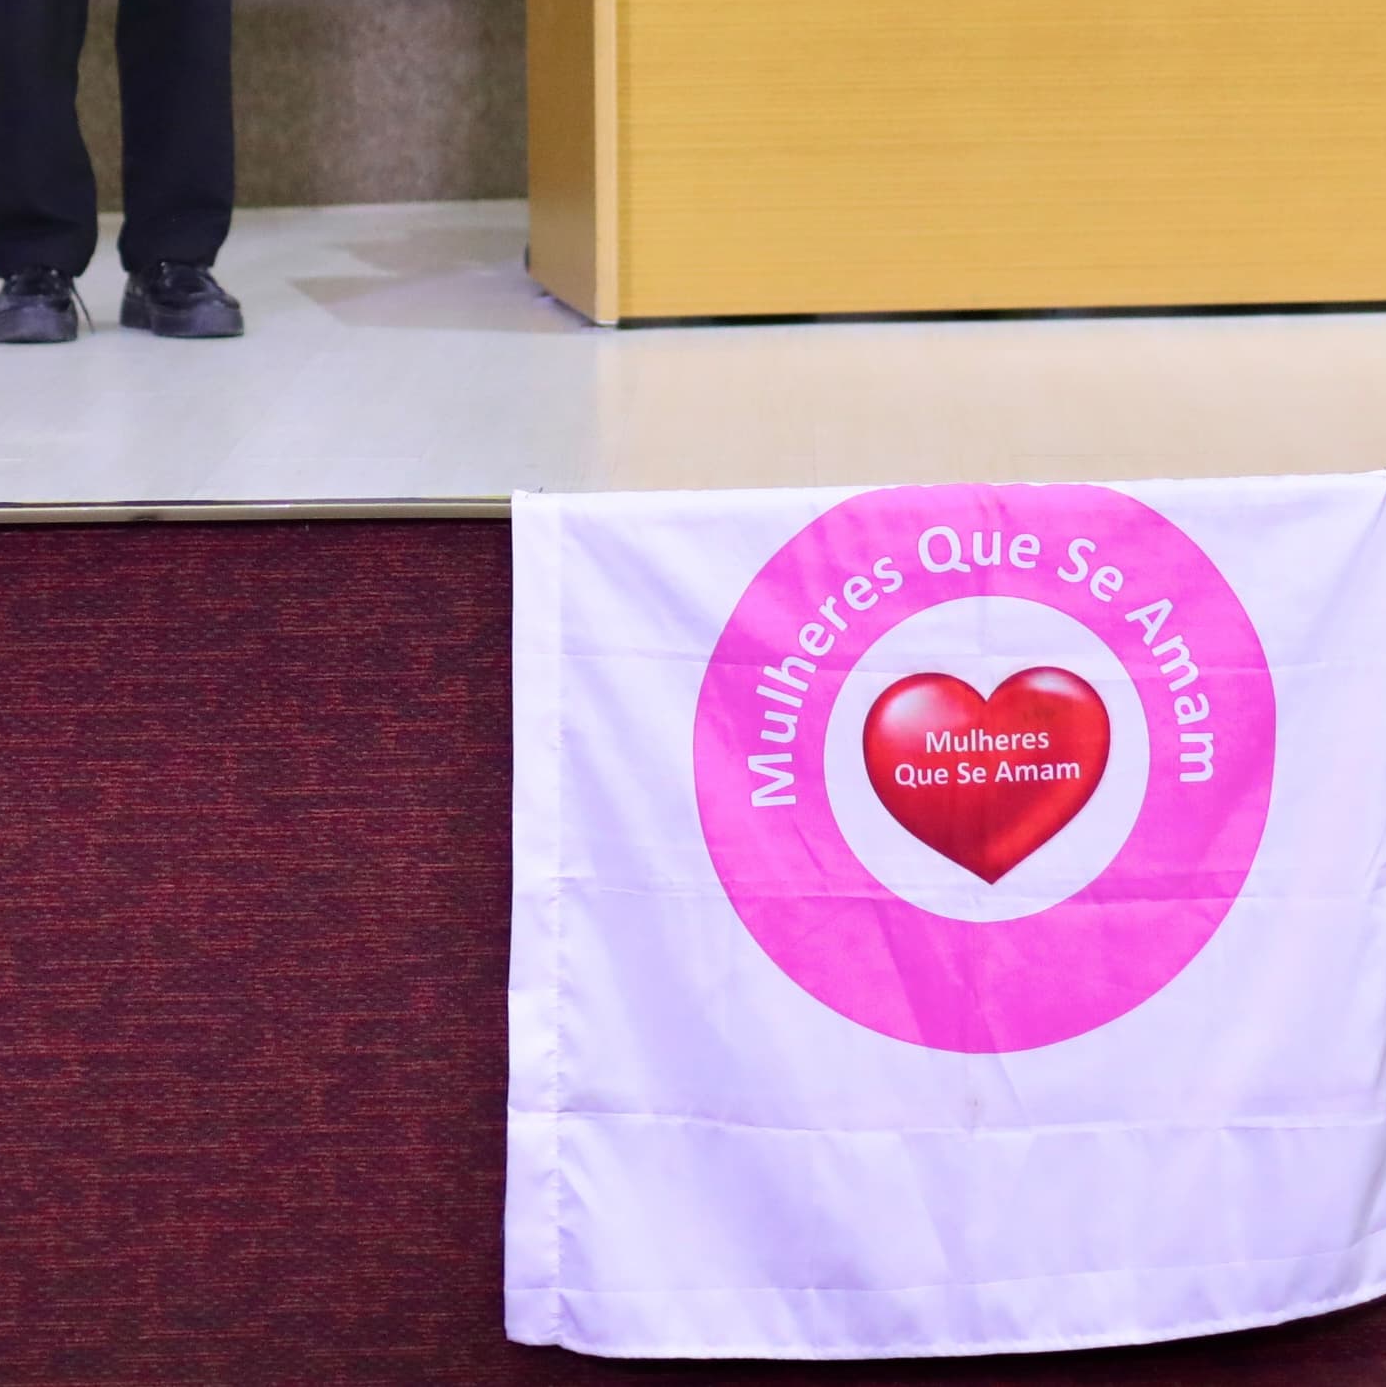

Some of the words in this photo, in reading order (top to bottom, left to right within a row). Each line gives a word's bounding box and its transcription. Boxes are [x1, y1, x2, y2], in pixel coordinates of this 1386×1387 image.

[748, 556, 904, 808] Mulheres
[918, 525, 1041, 574] Que
[1057, 537, 1124, 602] Se
[1125, 598, 1214, 783] Amam
[925, 728, 1050, 754] Mulheres
[894, 763, 949, 787] Que
[957, 761, 987, 784] Se
[994, 759, 1080, 783] Amam
